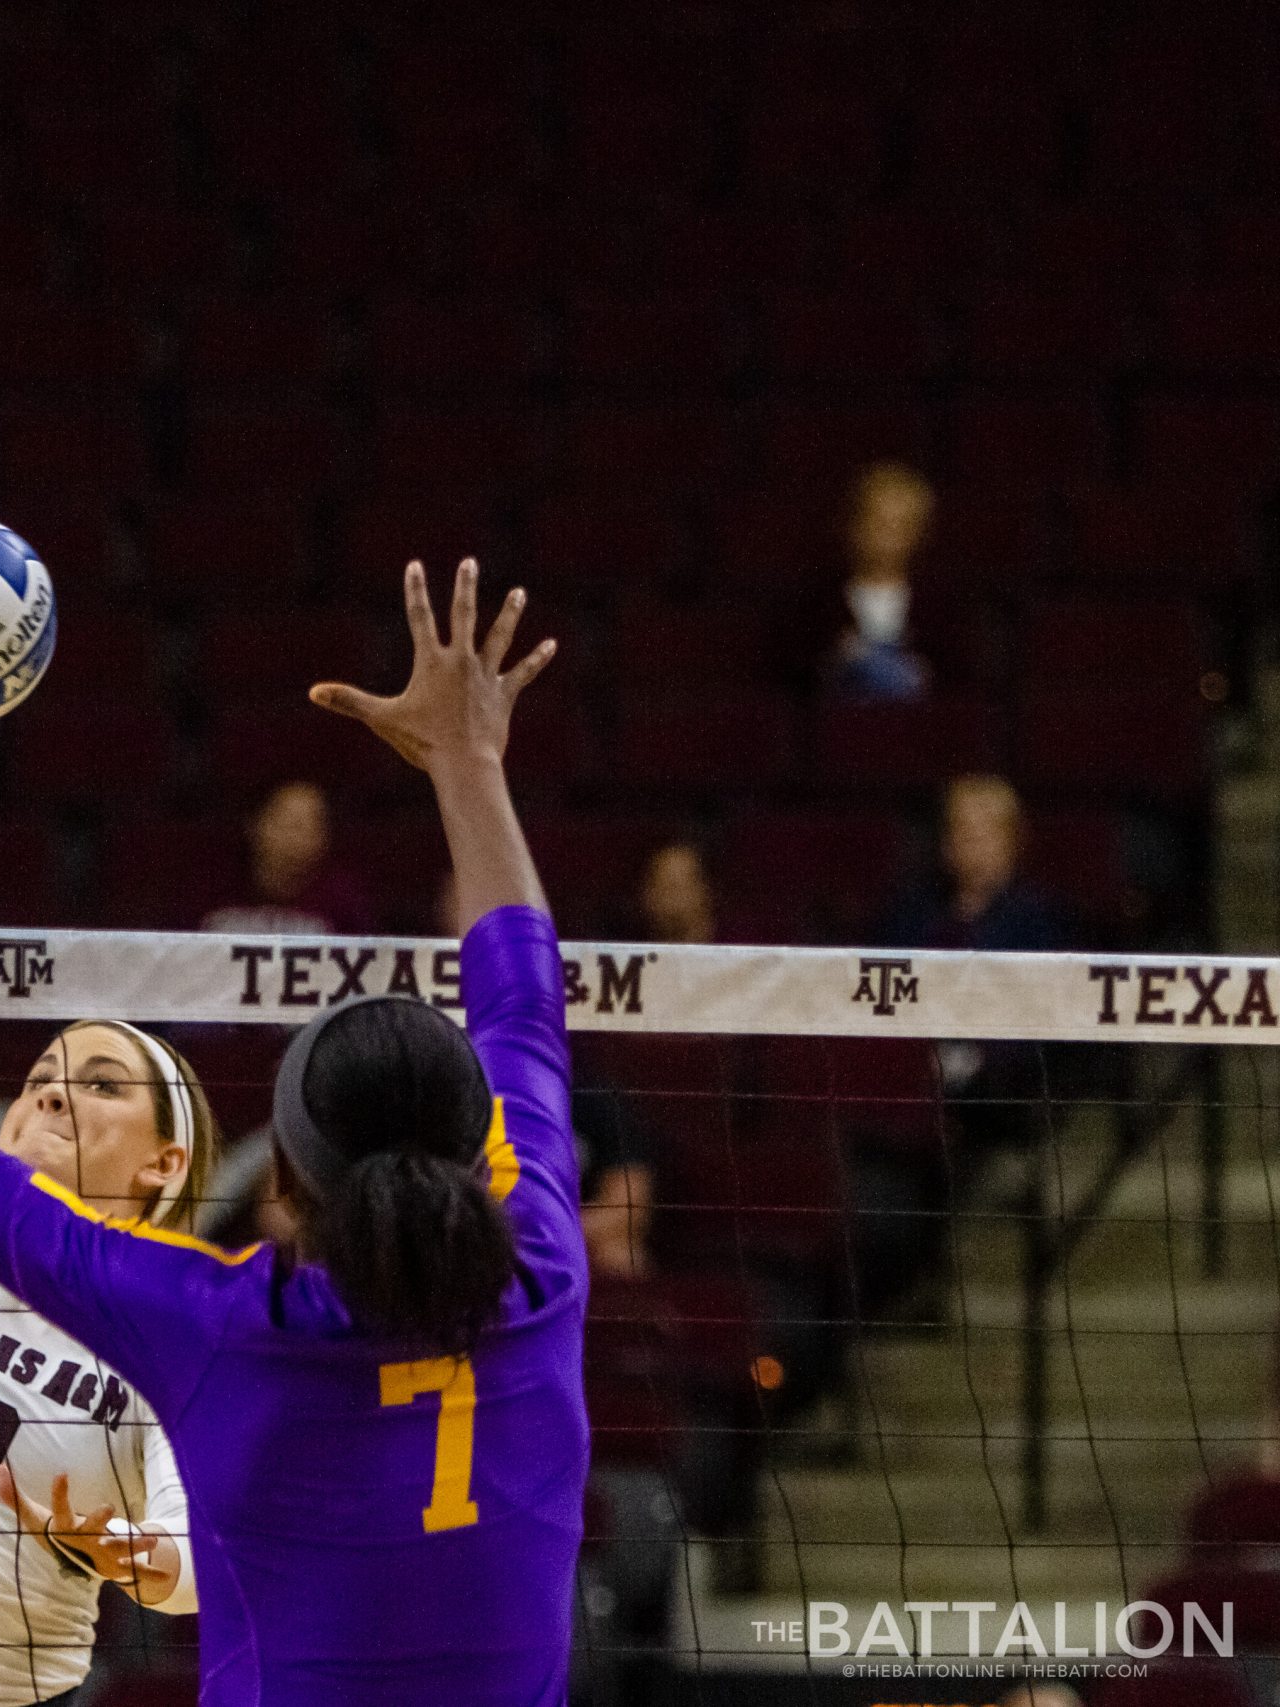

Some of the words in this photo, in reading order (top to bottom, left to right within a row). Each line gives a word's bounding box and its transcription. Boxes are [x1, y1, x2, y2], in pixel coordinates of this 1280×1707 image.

[230, 945, 466, 1008] TEXAS
[561, 953, 645, 1014] &M
[1088, 965, 1278, 1027] TEXA
[40, 1359, 130, 1433] A&M
[378, 1353, 479, 1534] 7
